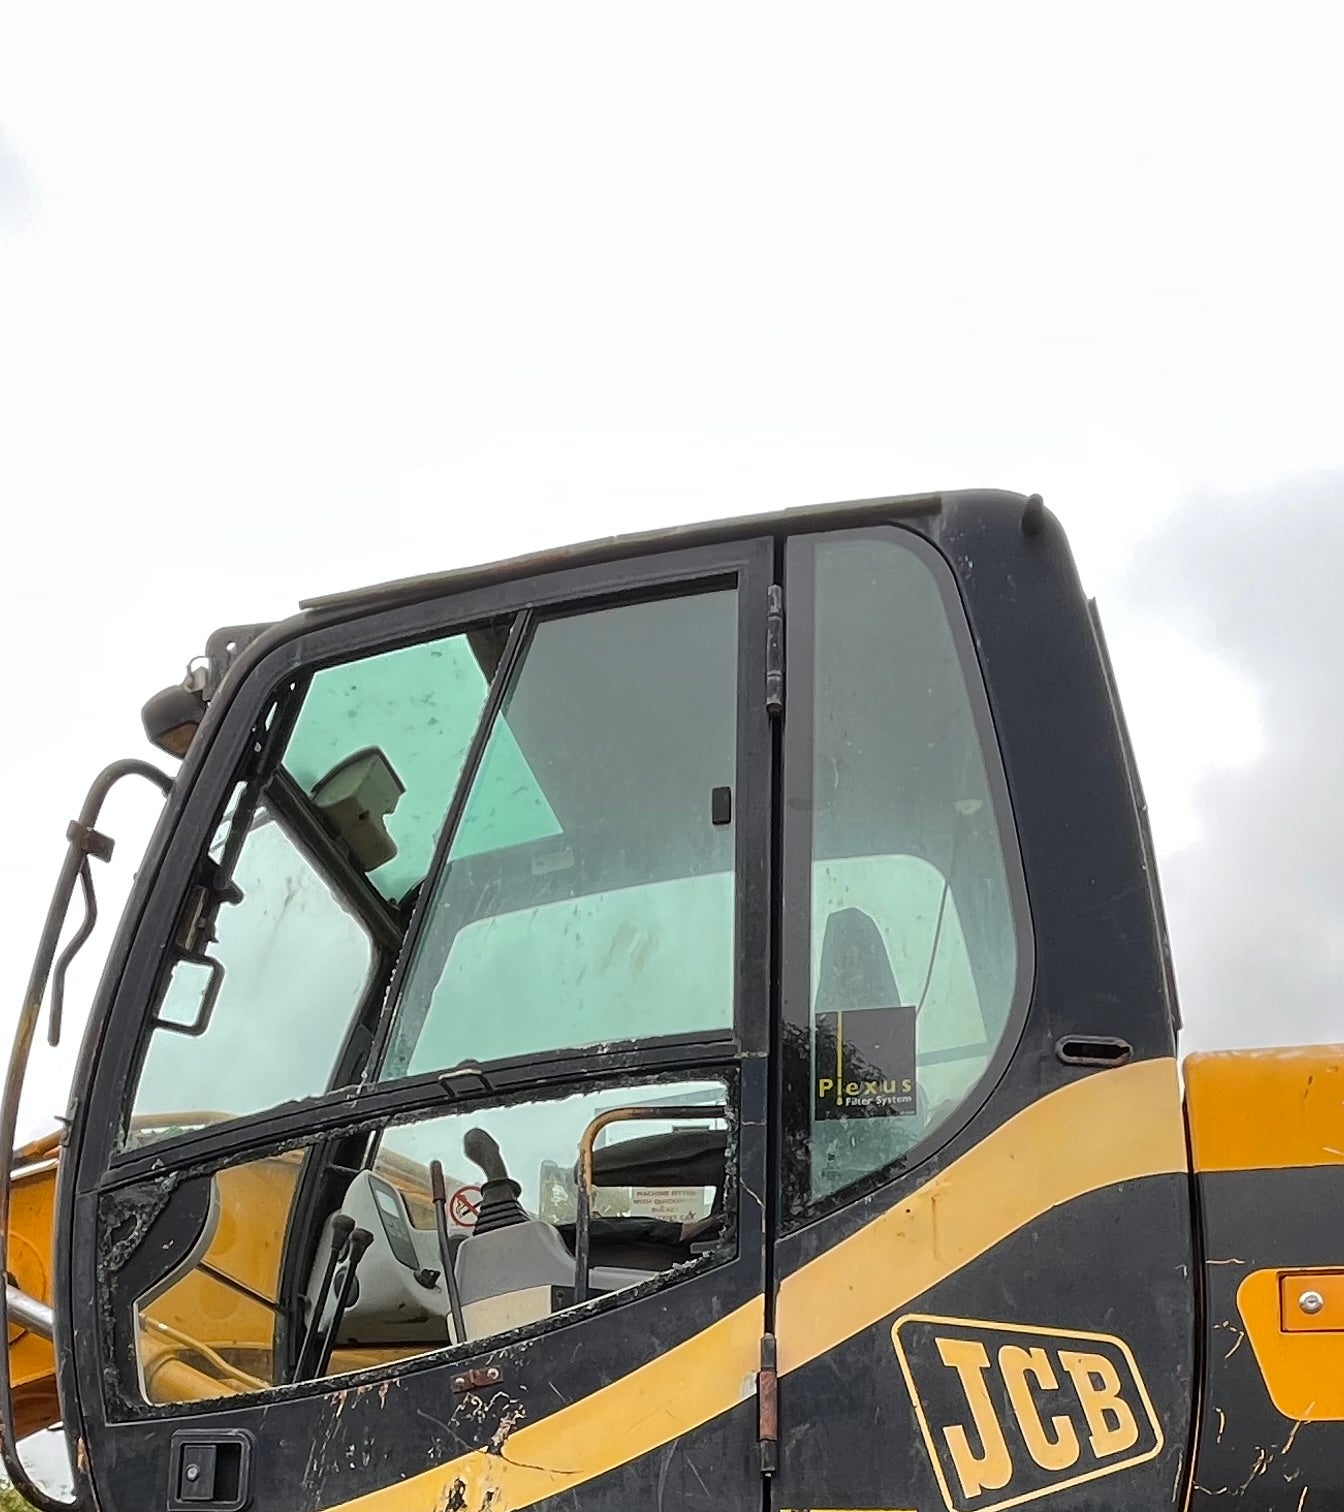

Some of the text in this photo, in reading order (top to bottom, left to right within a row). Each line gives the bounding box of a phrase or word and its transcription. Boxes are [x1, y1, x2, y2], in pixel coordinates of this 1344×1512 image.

[819, 1078, 912, 1099] Plexus
[845, 1095, 913, 1107] Filter System
[935, 1337, 1139, 1499] JCB
